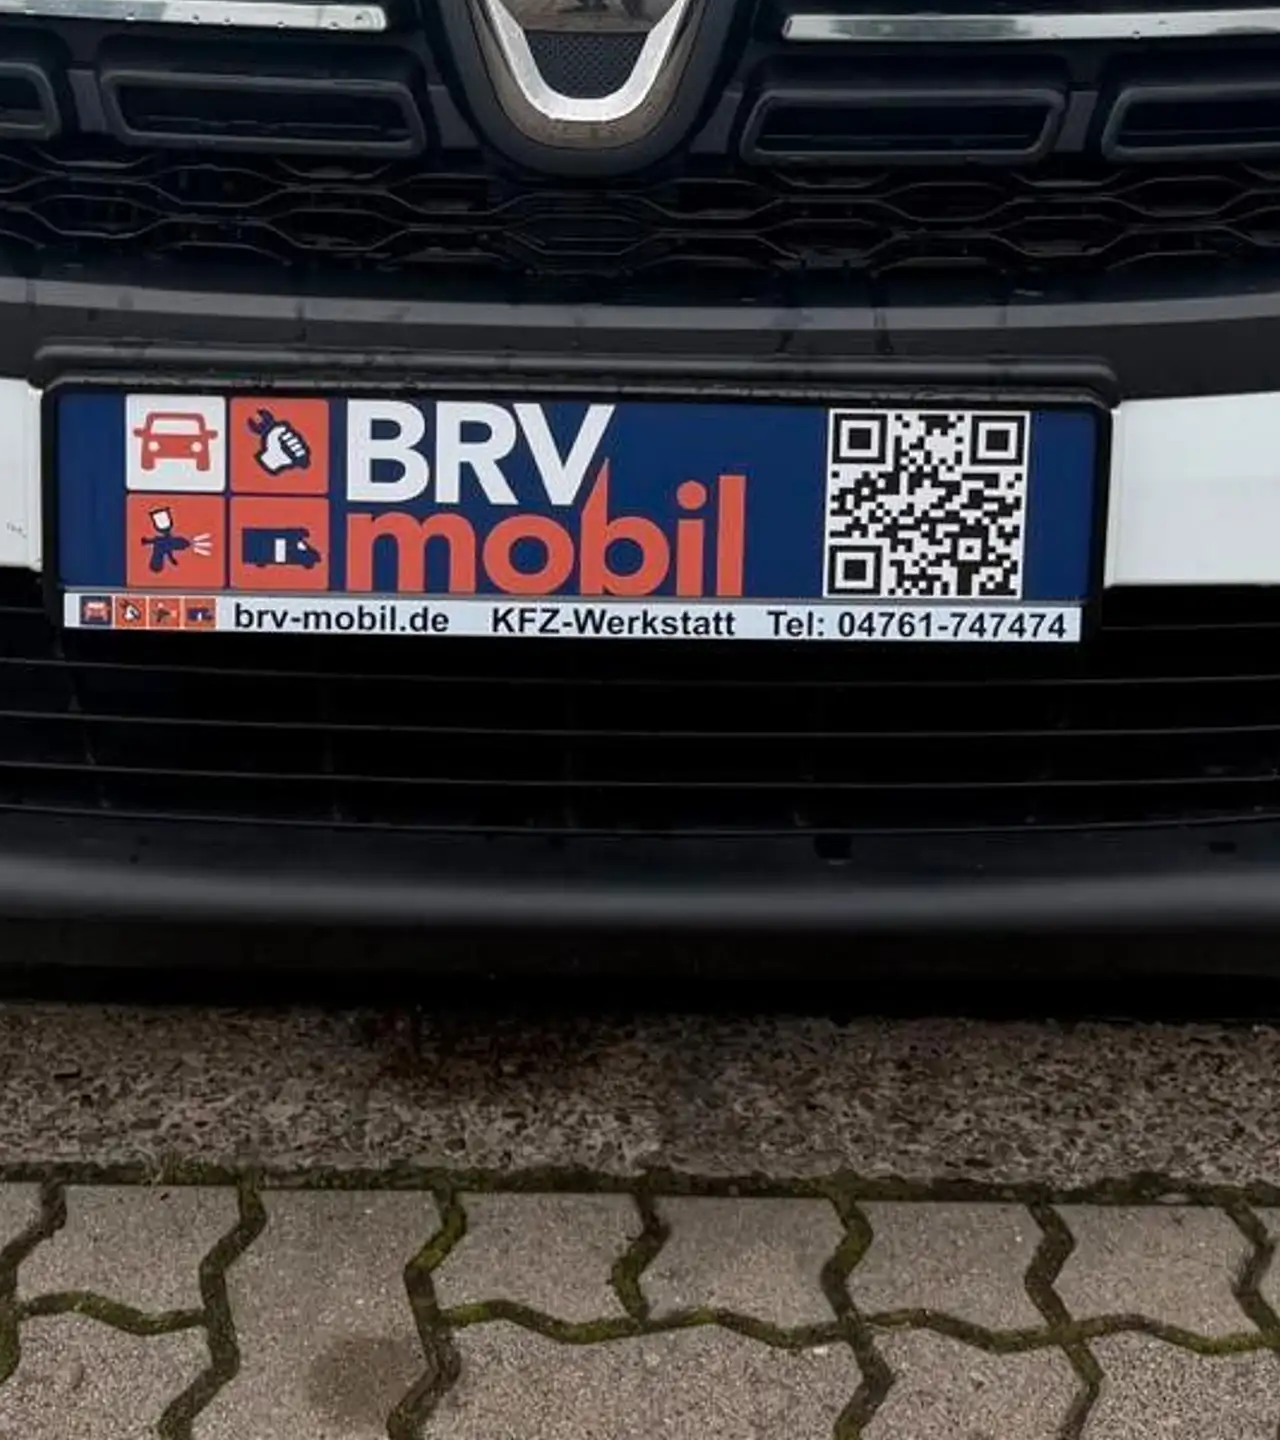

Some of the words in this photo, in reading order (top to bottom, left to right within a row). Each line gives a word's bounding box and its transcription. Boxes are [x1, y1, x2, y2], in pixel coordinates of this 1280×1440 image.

[345, 398, 616, 506] BRV
[345, 456, 747, 597] mobil
[234, 603, 450, 633] brv-mobil.de
[491, 608, 736, 636] KFZ-Werkstatt
[766, 609, 826, 637] Tel:
[838, 611, 1067, 639] 04761-747474
